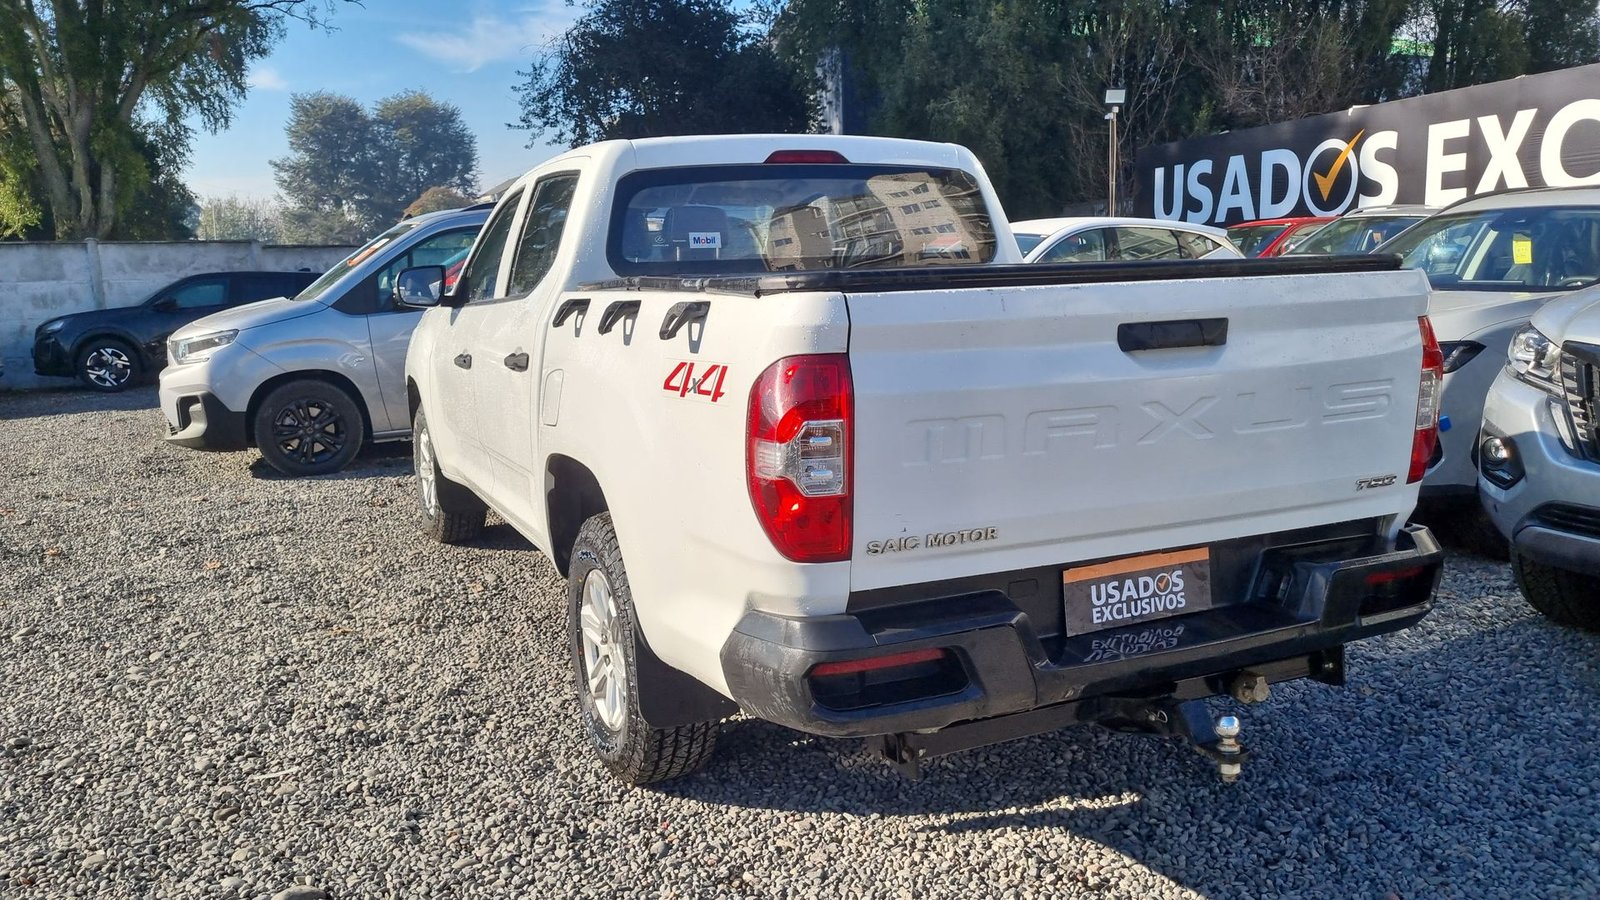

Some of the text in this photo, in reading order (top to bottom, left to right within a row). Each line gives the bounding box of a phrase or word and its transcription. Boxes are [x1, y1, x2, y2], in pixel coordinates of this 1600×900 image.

[1153, 130, 1399, 224] USADOS
[692, 236, 716, 245] Mobil
[663, 361, 728, 402] 4x4
[901, 377, 1395, 467] MAXUS
[866, 526, 998, 556] SAIC MOTOR
[1090, 570, 1184, 606] USADOS
[1092, 592, 1186, 624] EXCLUSIVOS
